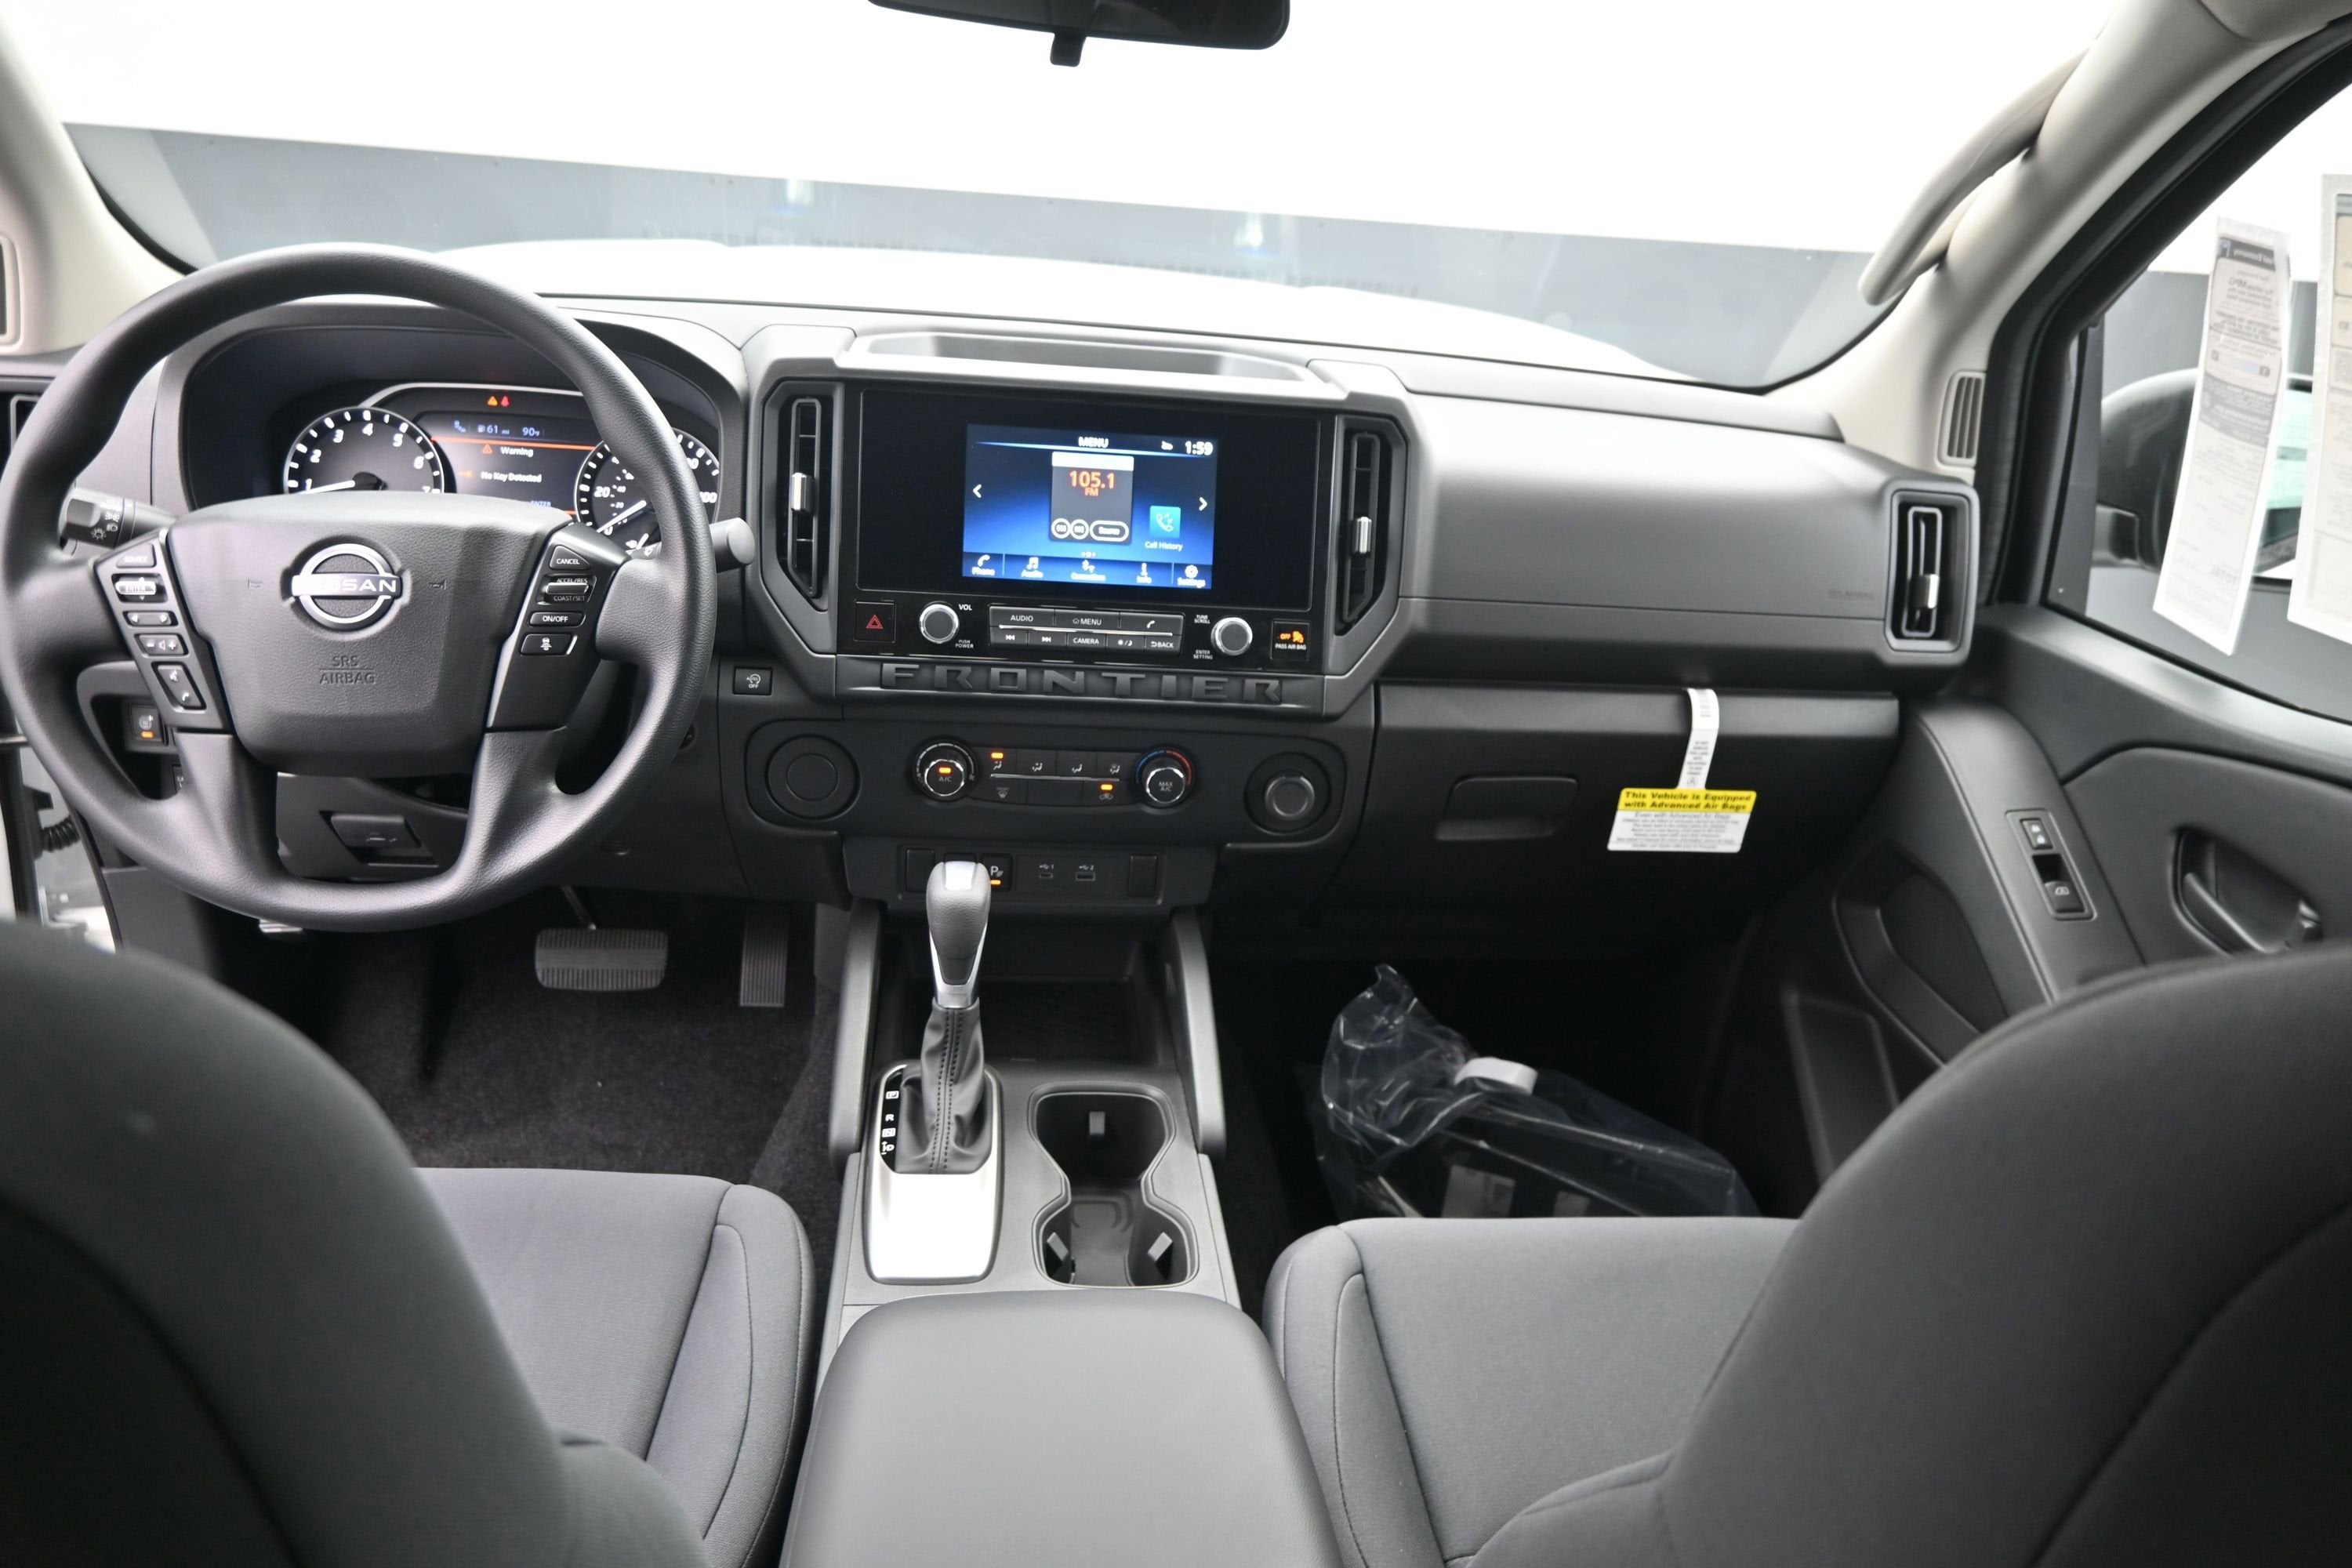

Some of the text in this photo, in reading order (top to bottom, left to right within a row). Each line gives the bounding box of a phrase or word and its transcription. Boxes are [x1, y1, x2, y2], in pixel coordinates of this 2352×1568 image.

[362, 423, 373, 437] 4
[487, 424, 498, 434] 61
[333, 429, 344, 443] 3
[393, 433, 403, 447] 5
[1078, 436, 1109, 448] MENU
[500, 446, 534, 458] Warning
[1185, 441, 1214, 456] 1:59
[310, 448, 321, 463] 2
[414, 456, 424, 469] 6
[481, 471, 543, 483] No Key Detected
[1069, 470, 1116, 490] 105.1
[593, 486, 611, 498] 20
[1084, 487, 1099, 497] FM
[1145, 541, 1183, 552] Call History
[296, 577, 396, 593] SSAN
[1080, 618, 1102, 626] MENU
[332, 655, 358, 668] SRS
[319, 672, 376, 685] AIRBAG
[881, 662, 1281, 703] FRONTIER
[1625, 791, 1647, 800] This
[1704, 793, 1751, 802] Equipped
[990, 866, 999, 877] P
